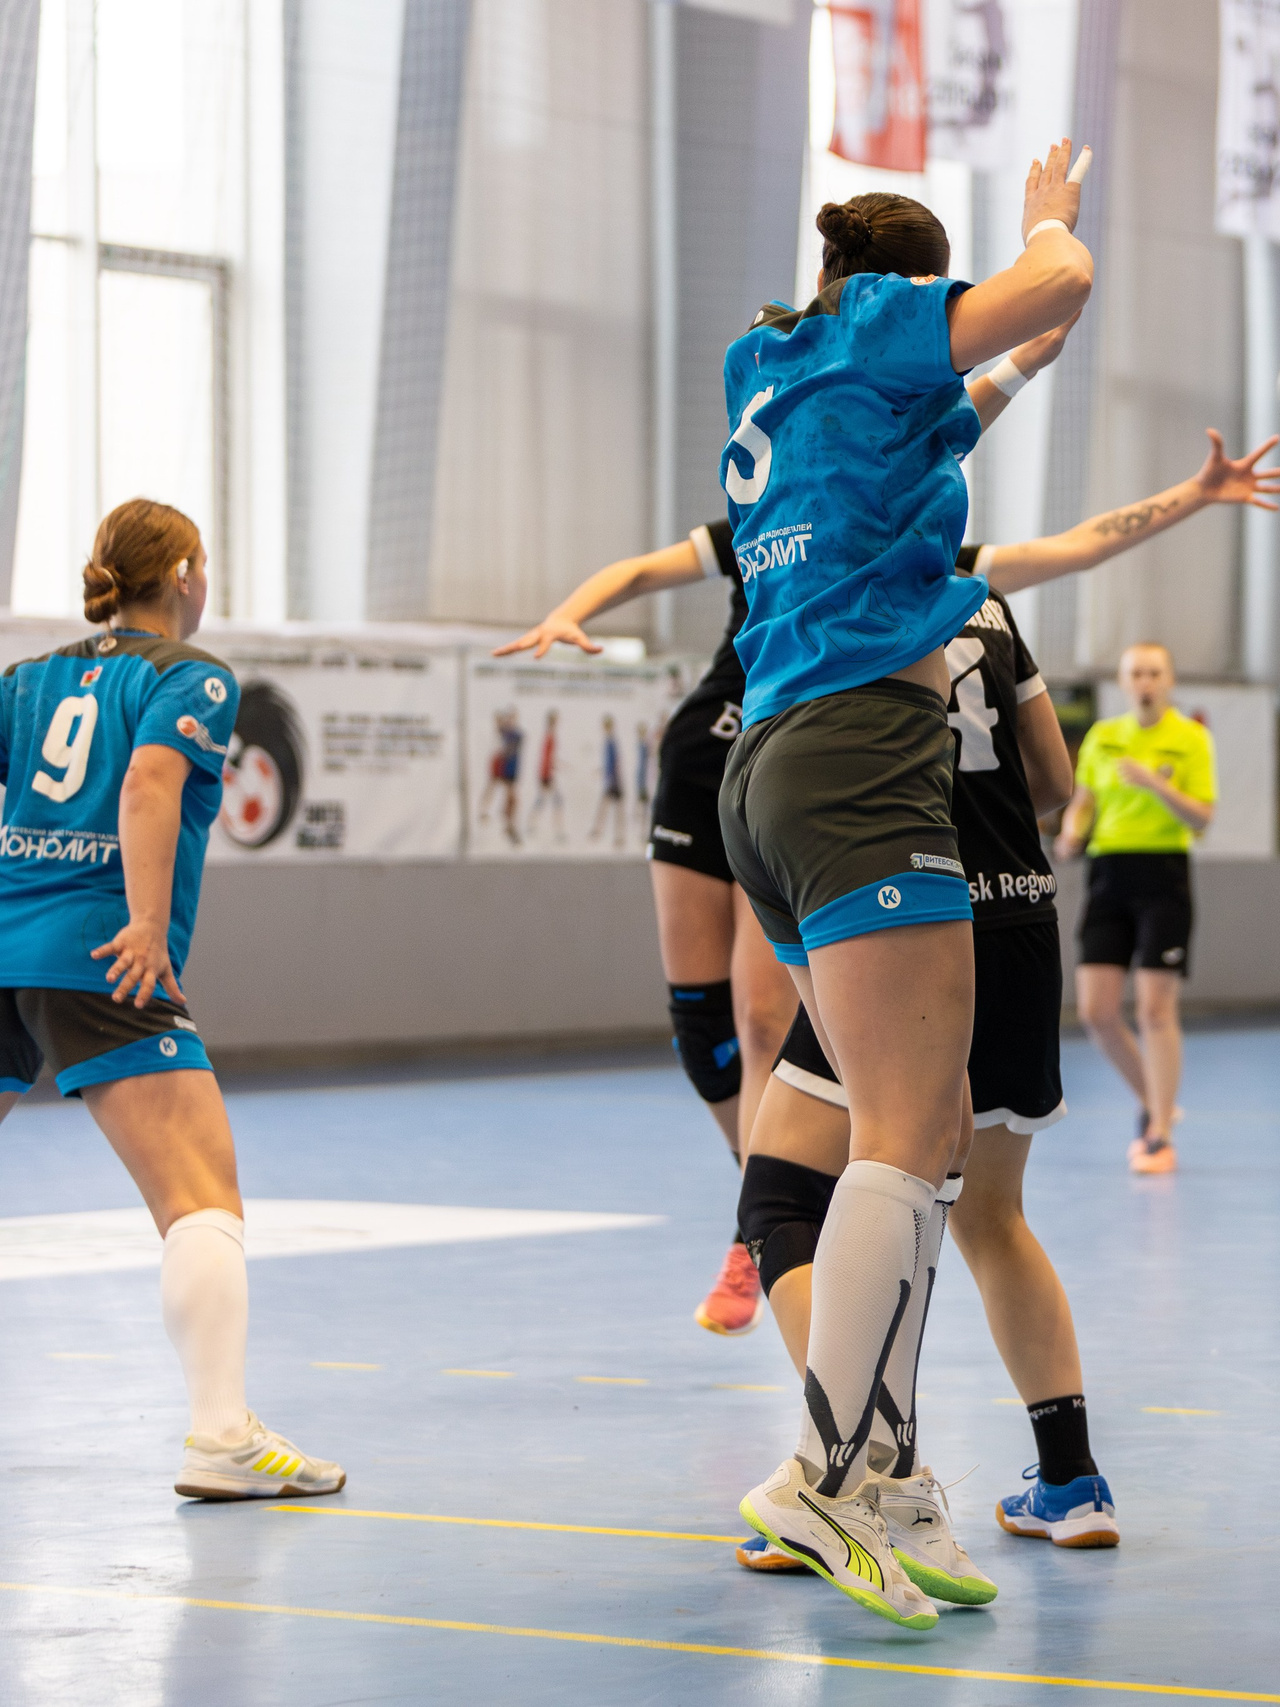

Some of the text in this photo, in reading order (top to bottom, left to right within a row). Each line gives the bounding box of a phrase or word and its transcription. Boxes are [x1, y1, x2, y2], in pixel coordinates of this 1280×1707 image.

[739, 534, 812, 583] ОНОЛИТ
[31, 693, 98, 803] 9
[998, 869, 1056, 904] Region
